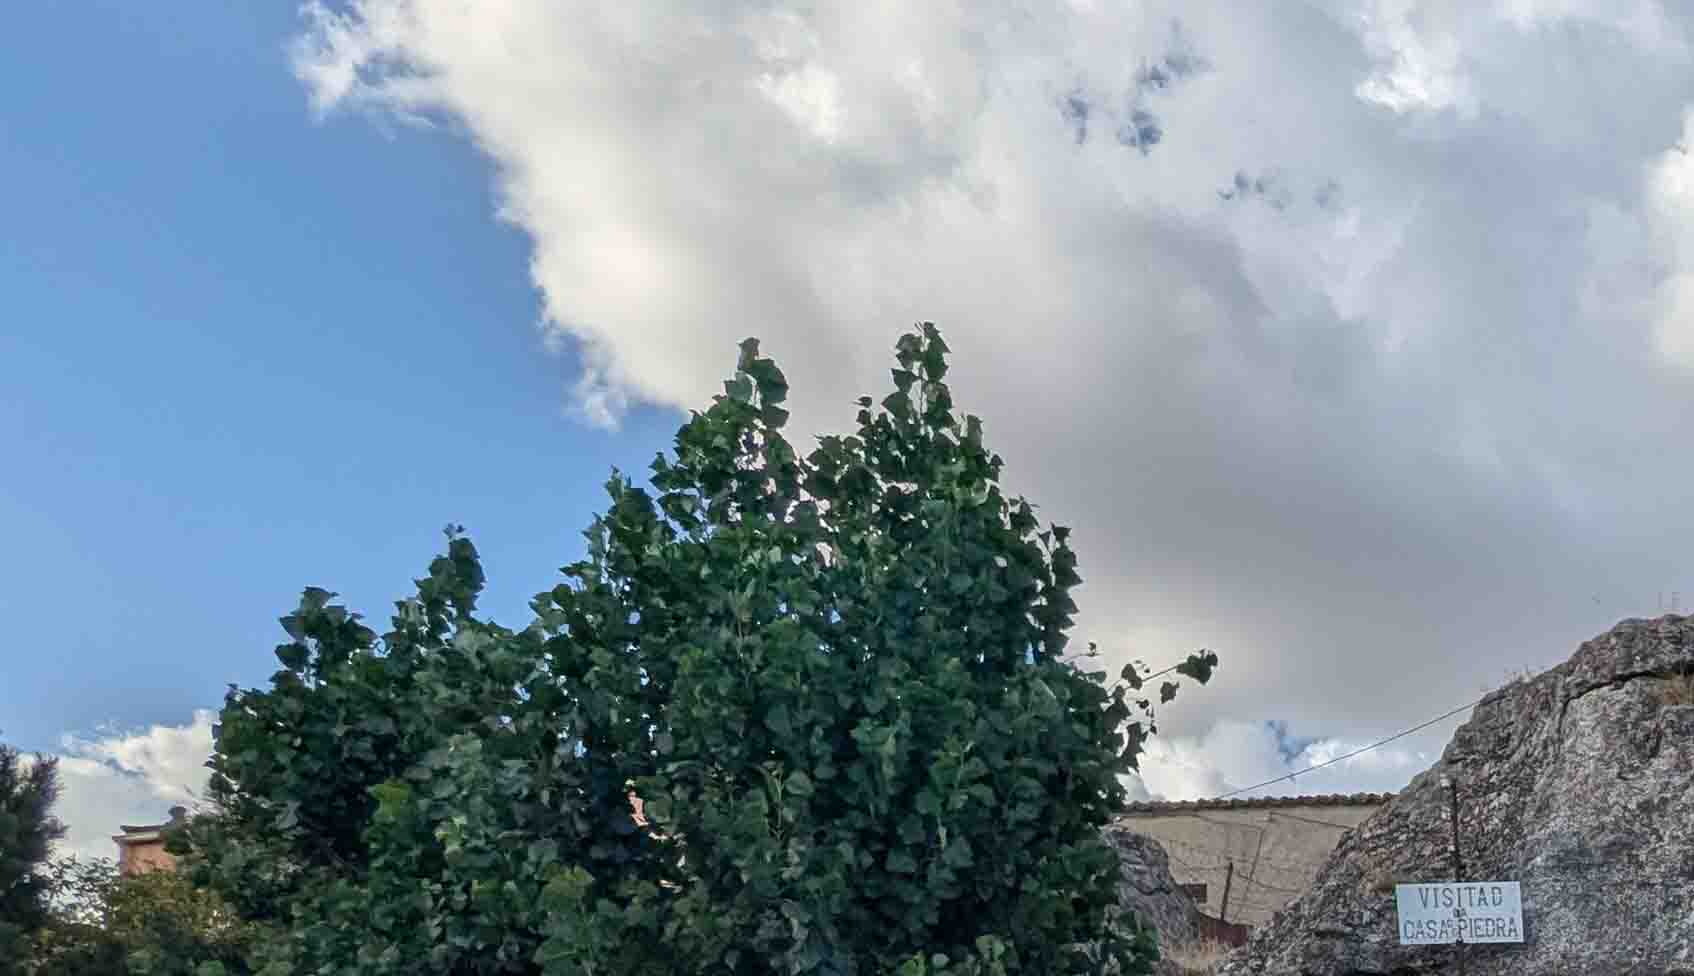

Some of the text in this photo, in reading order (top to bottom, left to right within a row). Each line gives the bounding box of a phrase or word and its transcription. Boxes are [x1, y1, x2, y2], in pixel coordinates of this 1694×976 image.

[1418, 886, 1503, 909] VISITAD
[1403, 919, 1449, 940] CASA
[1458, 917, 1519, 939] PIEDRA
